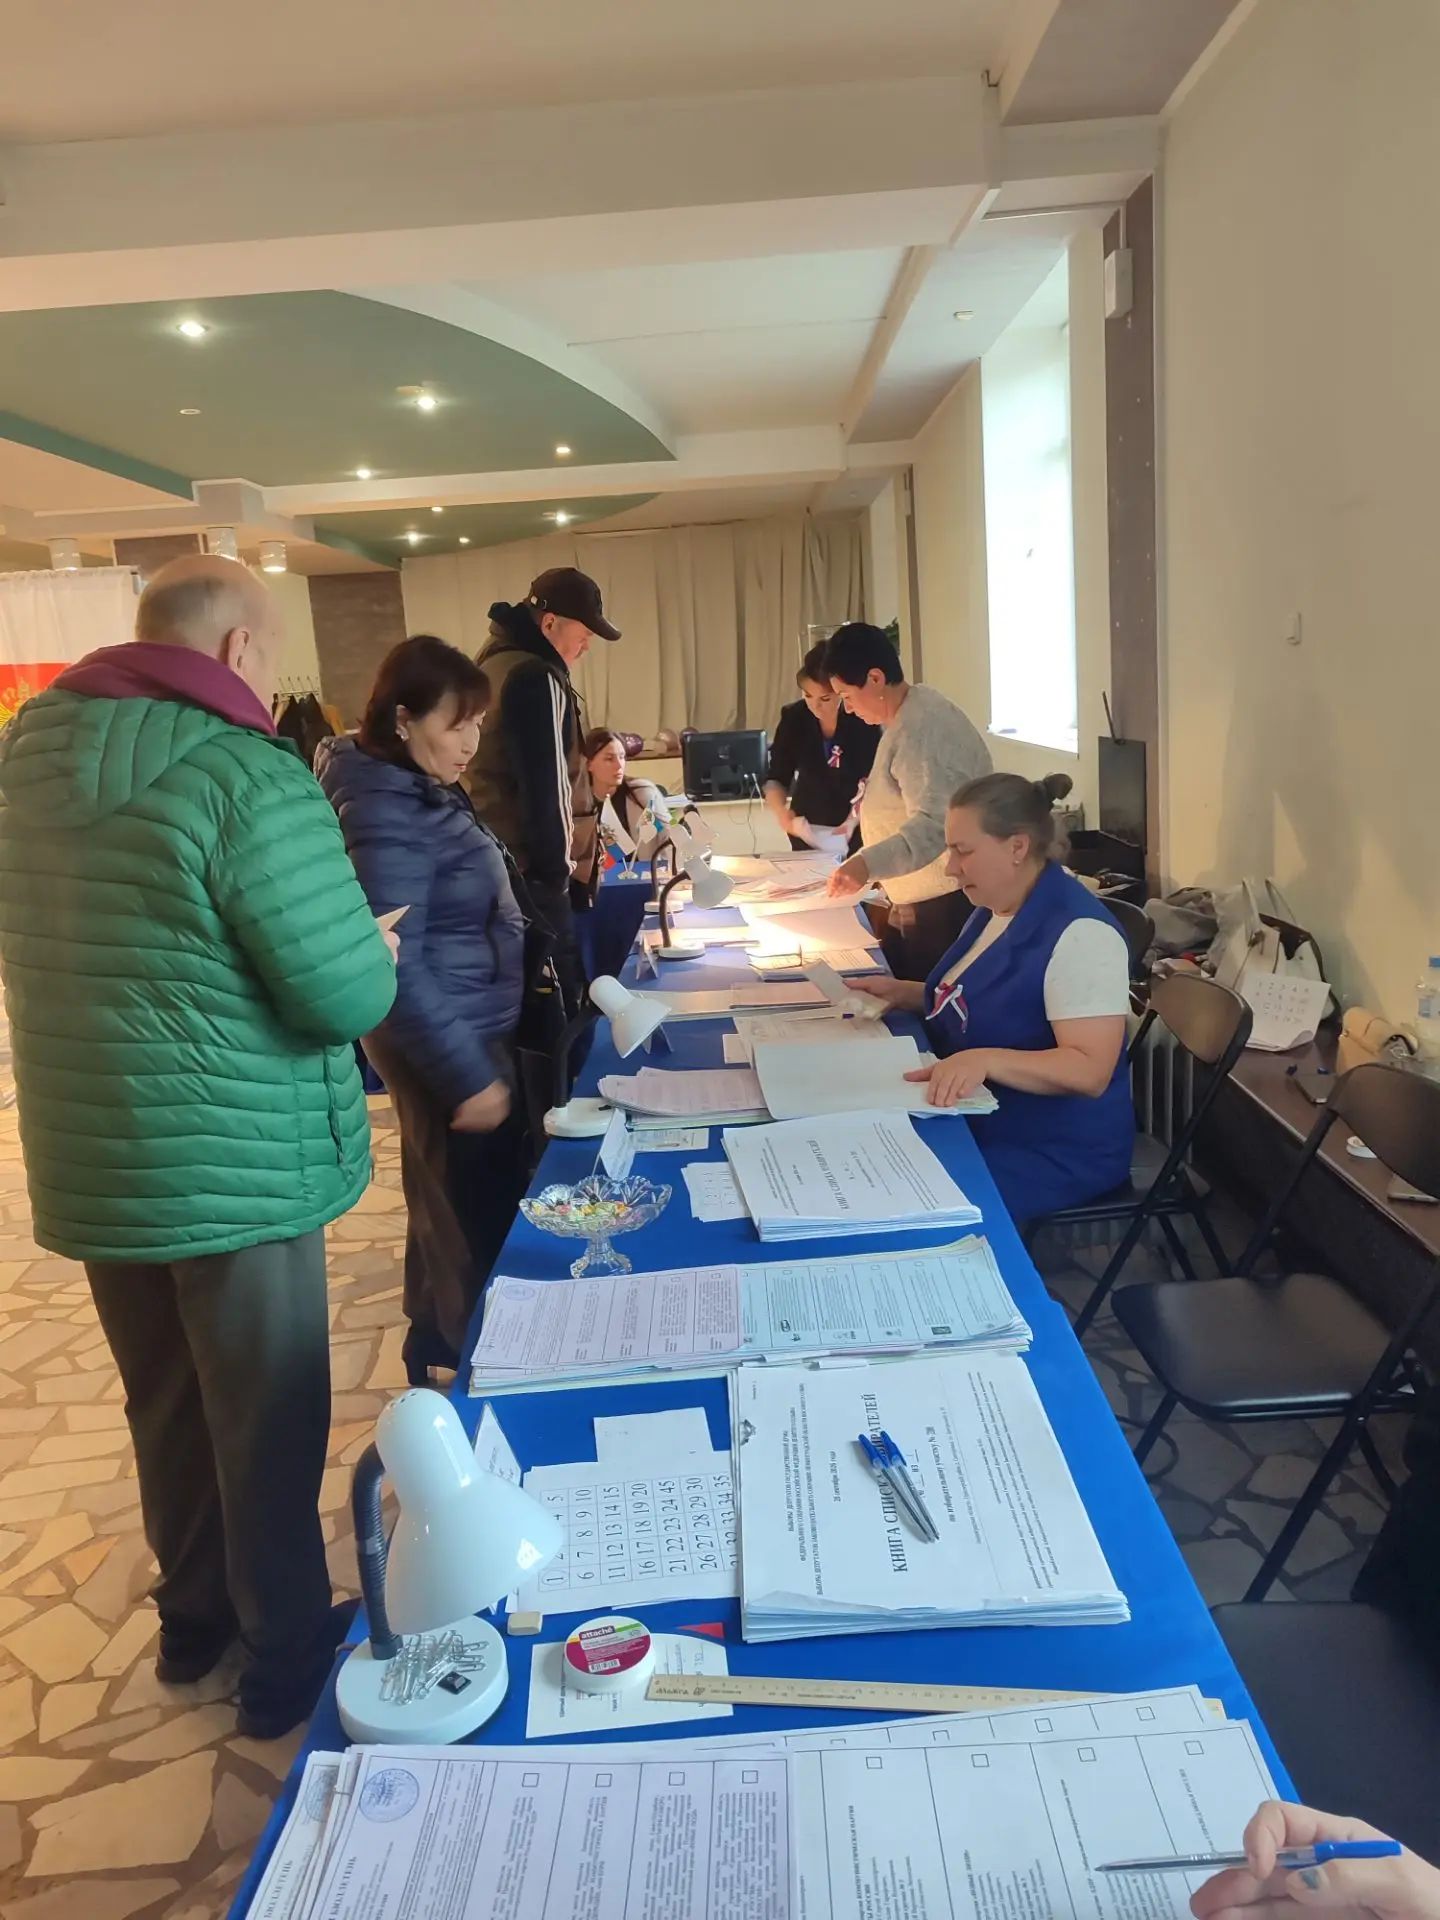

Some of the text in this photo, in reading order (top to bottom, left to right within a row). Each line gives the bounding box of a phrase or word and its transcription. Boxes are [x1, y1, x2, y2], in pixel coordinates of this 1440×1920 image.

[713, 1474, 731, 1488] 35
[575, 1489, 592, 1501] 10
[717, 1492, 734, 1505] 34
[661, 1498, 679, 1512] 24
[631, 1482, 657, 1575] 16 17 18 19 20
[663, 1517, 681, 1532] 23
[687, 1477, 718, 1570] 26 27 28 29 30
[576, 1530, 593, 1538] 8
[603, 1486, 626, 1579] 11 12 13 14 15
[665, 1537, 684, 1552] 22
[886, 1527, 908, 1572] КНИГА
[668, 1559, 687, 1573] 21
[577, 1571, 595, 1580] 6
